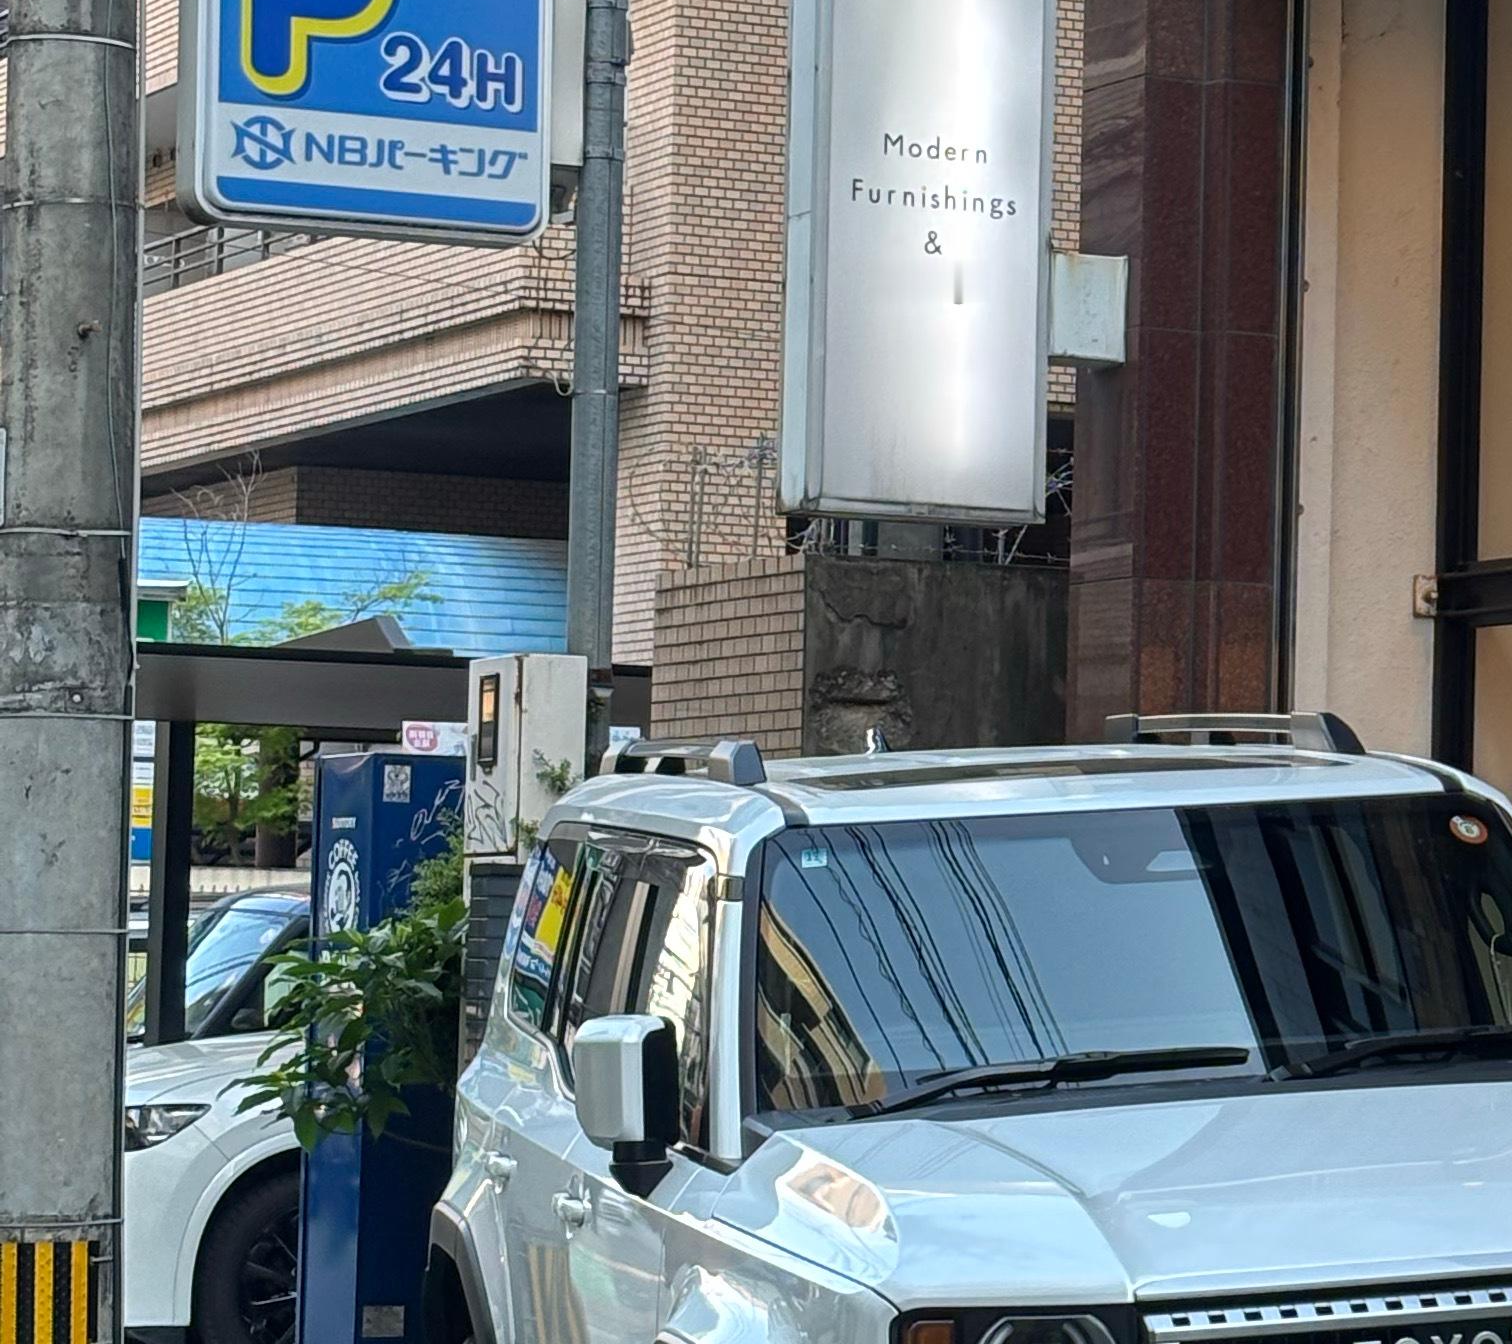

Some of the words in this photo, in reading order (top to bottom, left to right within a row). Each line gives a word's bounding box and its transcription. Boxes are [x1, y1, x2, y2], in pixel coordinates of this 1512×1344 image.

[380, 32, 524, 114] 24H
[304, 131, 528, 181] NBパーキング
[883, 132, 988, 165] Modern
[851, 178, 1018, 221] Furnishings
[923, 230, 943, 255] &
